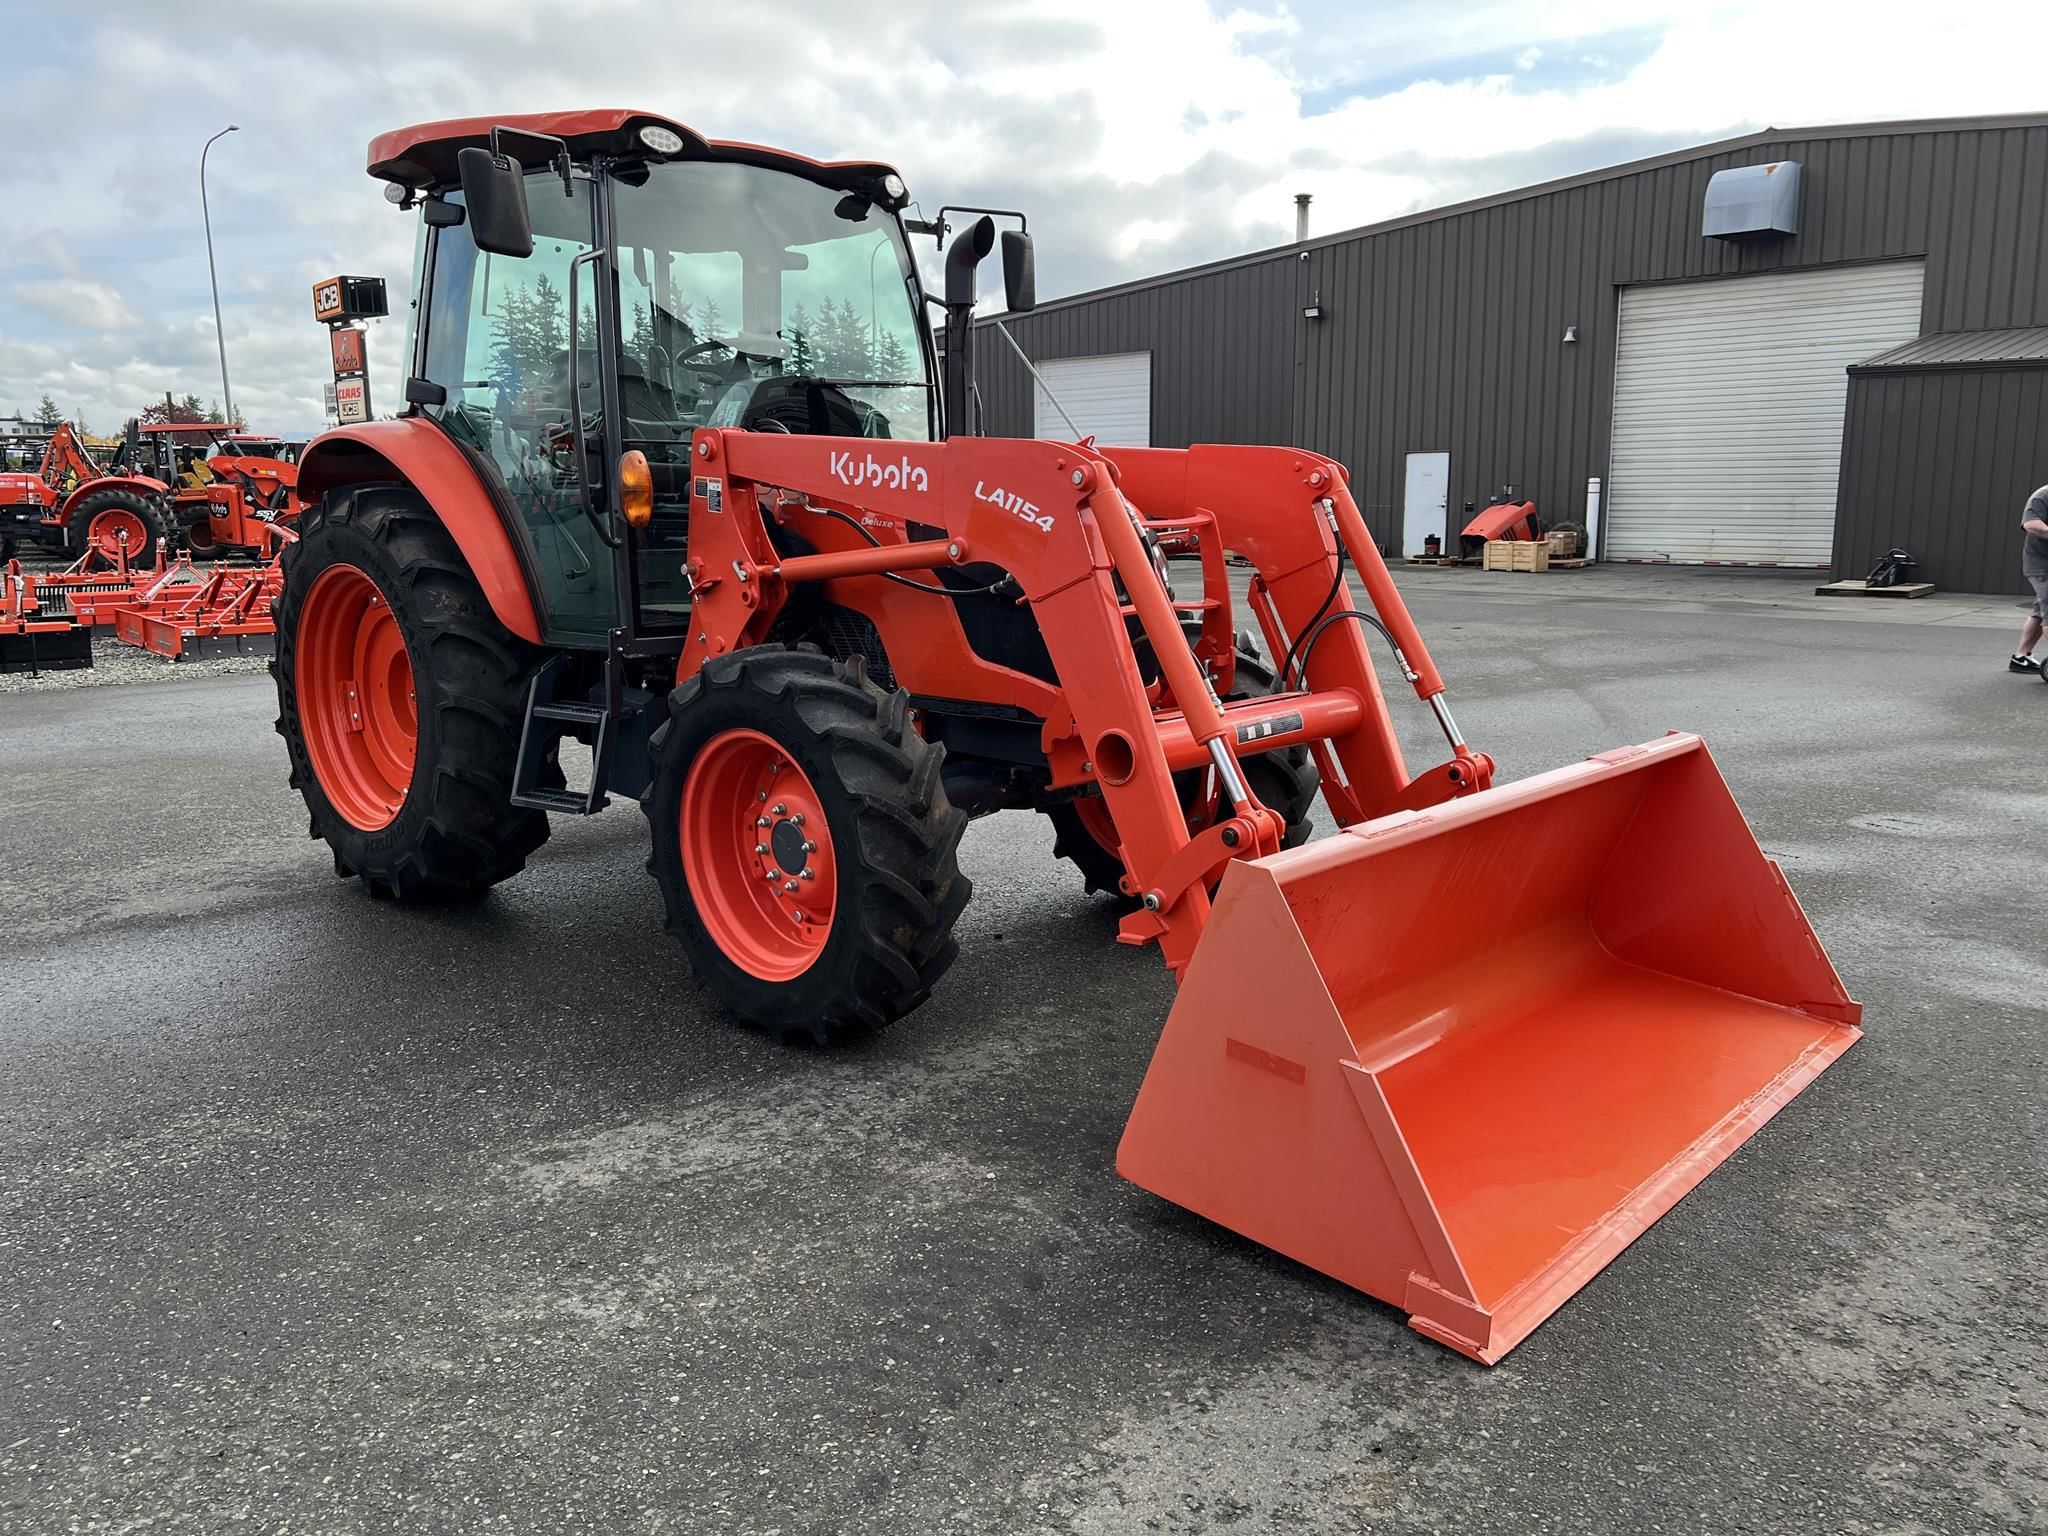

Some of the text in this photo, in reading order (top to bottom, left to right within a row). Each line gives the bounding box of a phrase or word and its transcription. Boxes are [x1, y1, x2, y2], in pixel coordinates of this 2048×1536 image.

[318, 285, 339, 312] JCB
[335, 354, 358, 368] Kubota
[338, 387, 361, 400] CLAAS
[342, 403, 359, 416] JCB
[830, 451, 928, 492] Kubota
[975, 480, 1055, 532] LA1154
[861, 517, 894, 529] Deluxe
